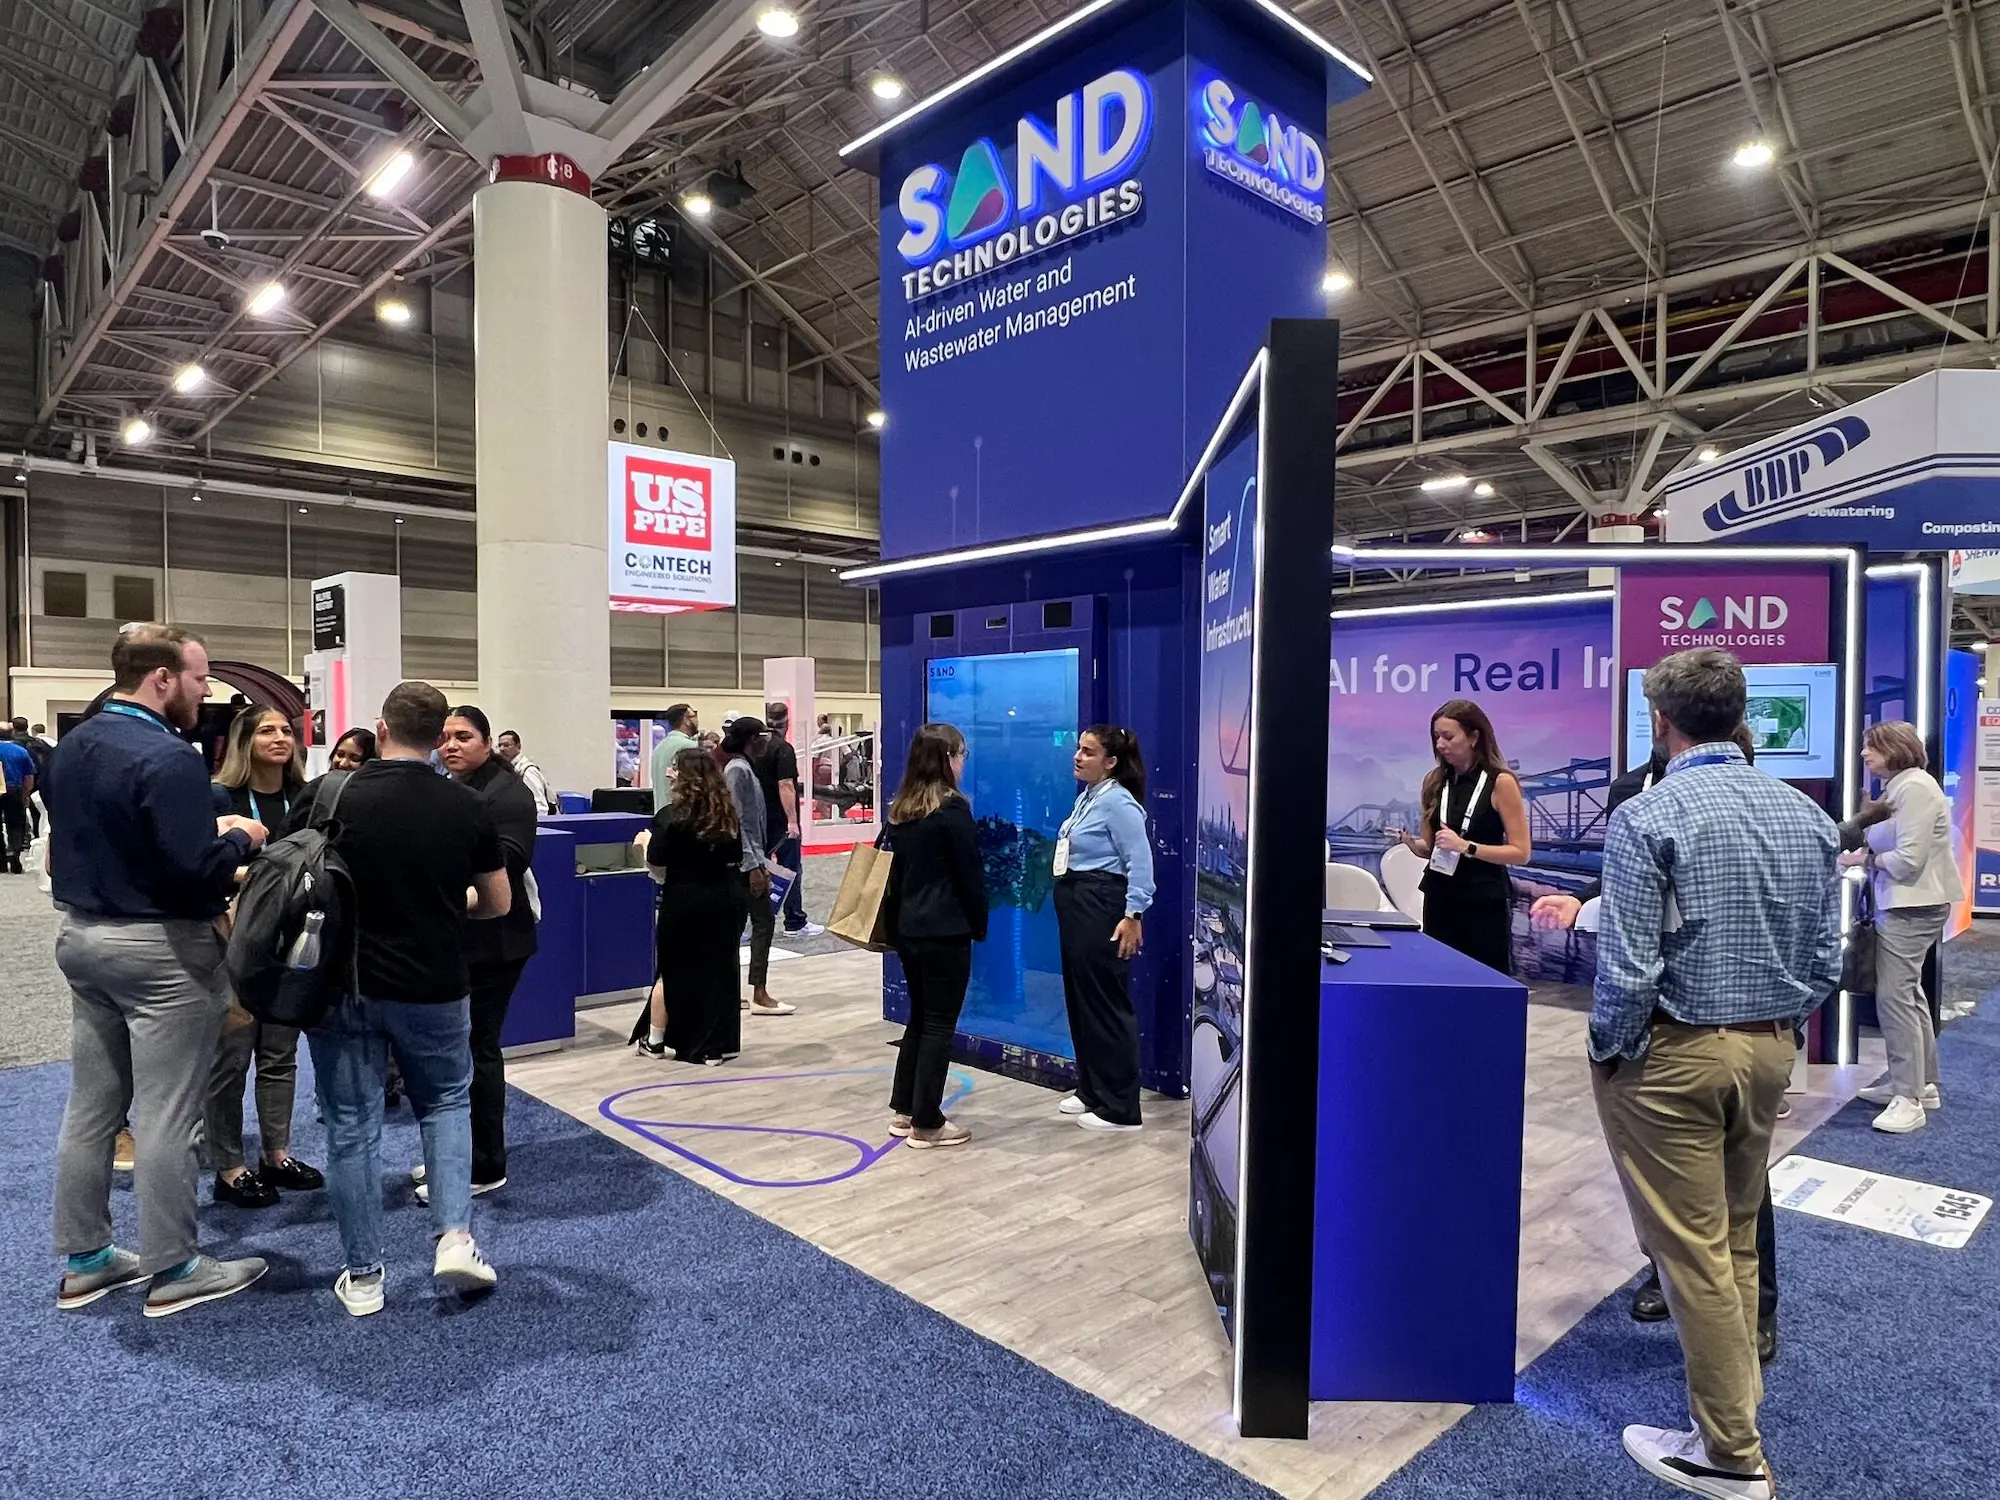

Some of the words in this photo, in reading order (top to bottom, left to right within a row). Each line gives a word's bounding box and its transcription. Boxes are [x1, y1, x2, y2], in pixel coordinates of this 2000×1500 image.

[1205, 79, 1325, 192] SAND
[898, 71, 1146, 257] SAND
[1204, 148, 1324, 224] TECHNOLOGIES
[902, 179, 1141, 300] TECHNOLOGIES
[904, 298, 975, 341] AI-driven
[979, 279, 1032, 312] Water
[1036, 258, 1073, 294] and
[904, 326, 1001, 372] Wastewater
[1006, 274, 1136, 340] Management
[630, 471, 707, 517] U.S.
[1744, 449, 1810, 508] BDP
[633, 509, 706, 538] PIPE
[1208, 510, 1231, 555] Smart
[1922, 521, 2000, 536] Compostin
[624, 568, 671, 581] ENGINEERED
[672, 573, 712, 584] SOLUTIONS
[625, 552, 712, 575] CONTECH
[1207, 568, 1230, 604] Water
[1659, 596, 1788, 630] SAND
[1661, 634, 1786, 646] TECHNOLOGIES
[1330, 656, 1358, 695] AI
[1373, 654, 1438, 694] for
[1454, 648, 1560, 692] Real
[1980, 873, 2000, 887] R
[1932, 1193, 1981, 1221] 1545
